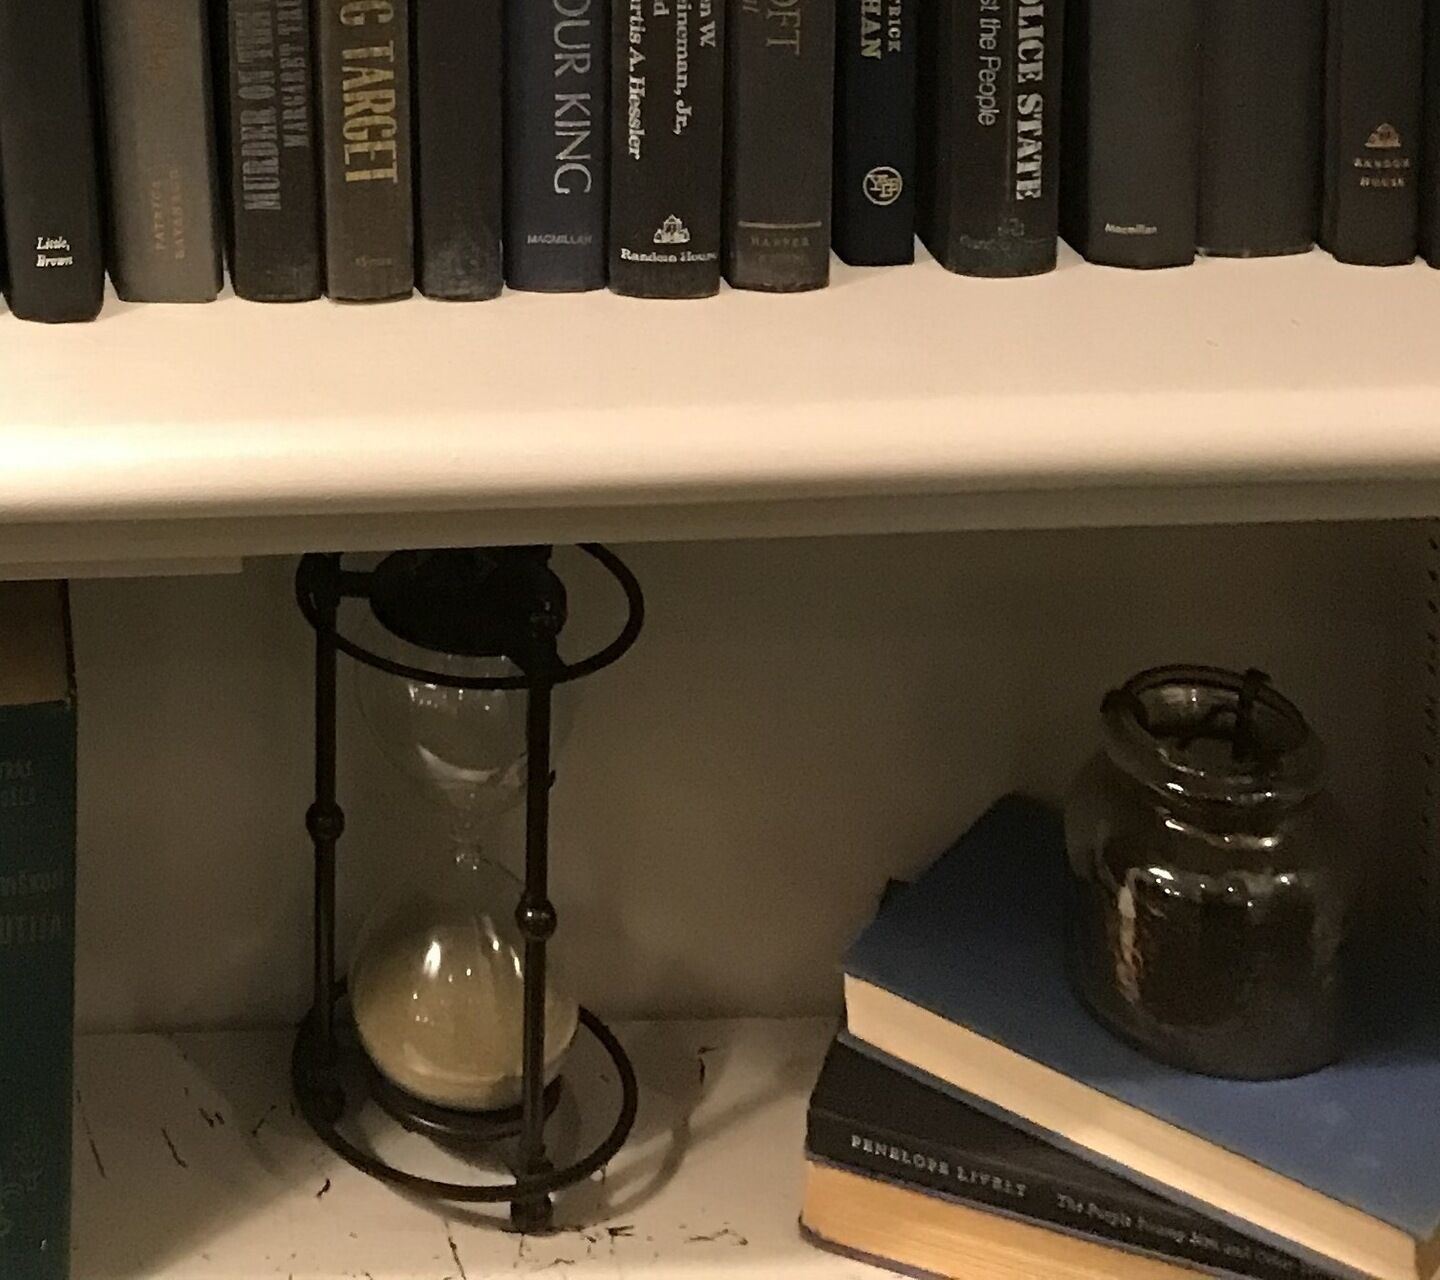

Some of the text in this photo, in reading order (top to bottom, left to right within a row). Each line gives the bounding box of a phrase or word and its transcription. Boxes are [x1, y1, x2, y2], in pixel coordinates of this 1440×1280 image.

[628, 47, 646, 73] A.
[699, 20, 716, 48] W.
[978, 17, 1002, 50] the
[340, 40, 399, 184] TARGET
[627, 75, 646, 160] Hessler
[975, 56, 1001, 127] People
[553, 91, 593, 195] KING
[1015, 93, 1044, 201] STATE
